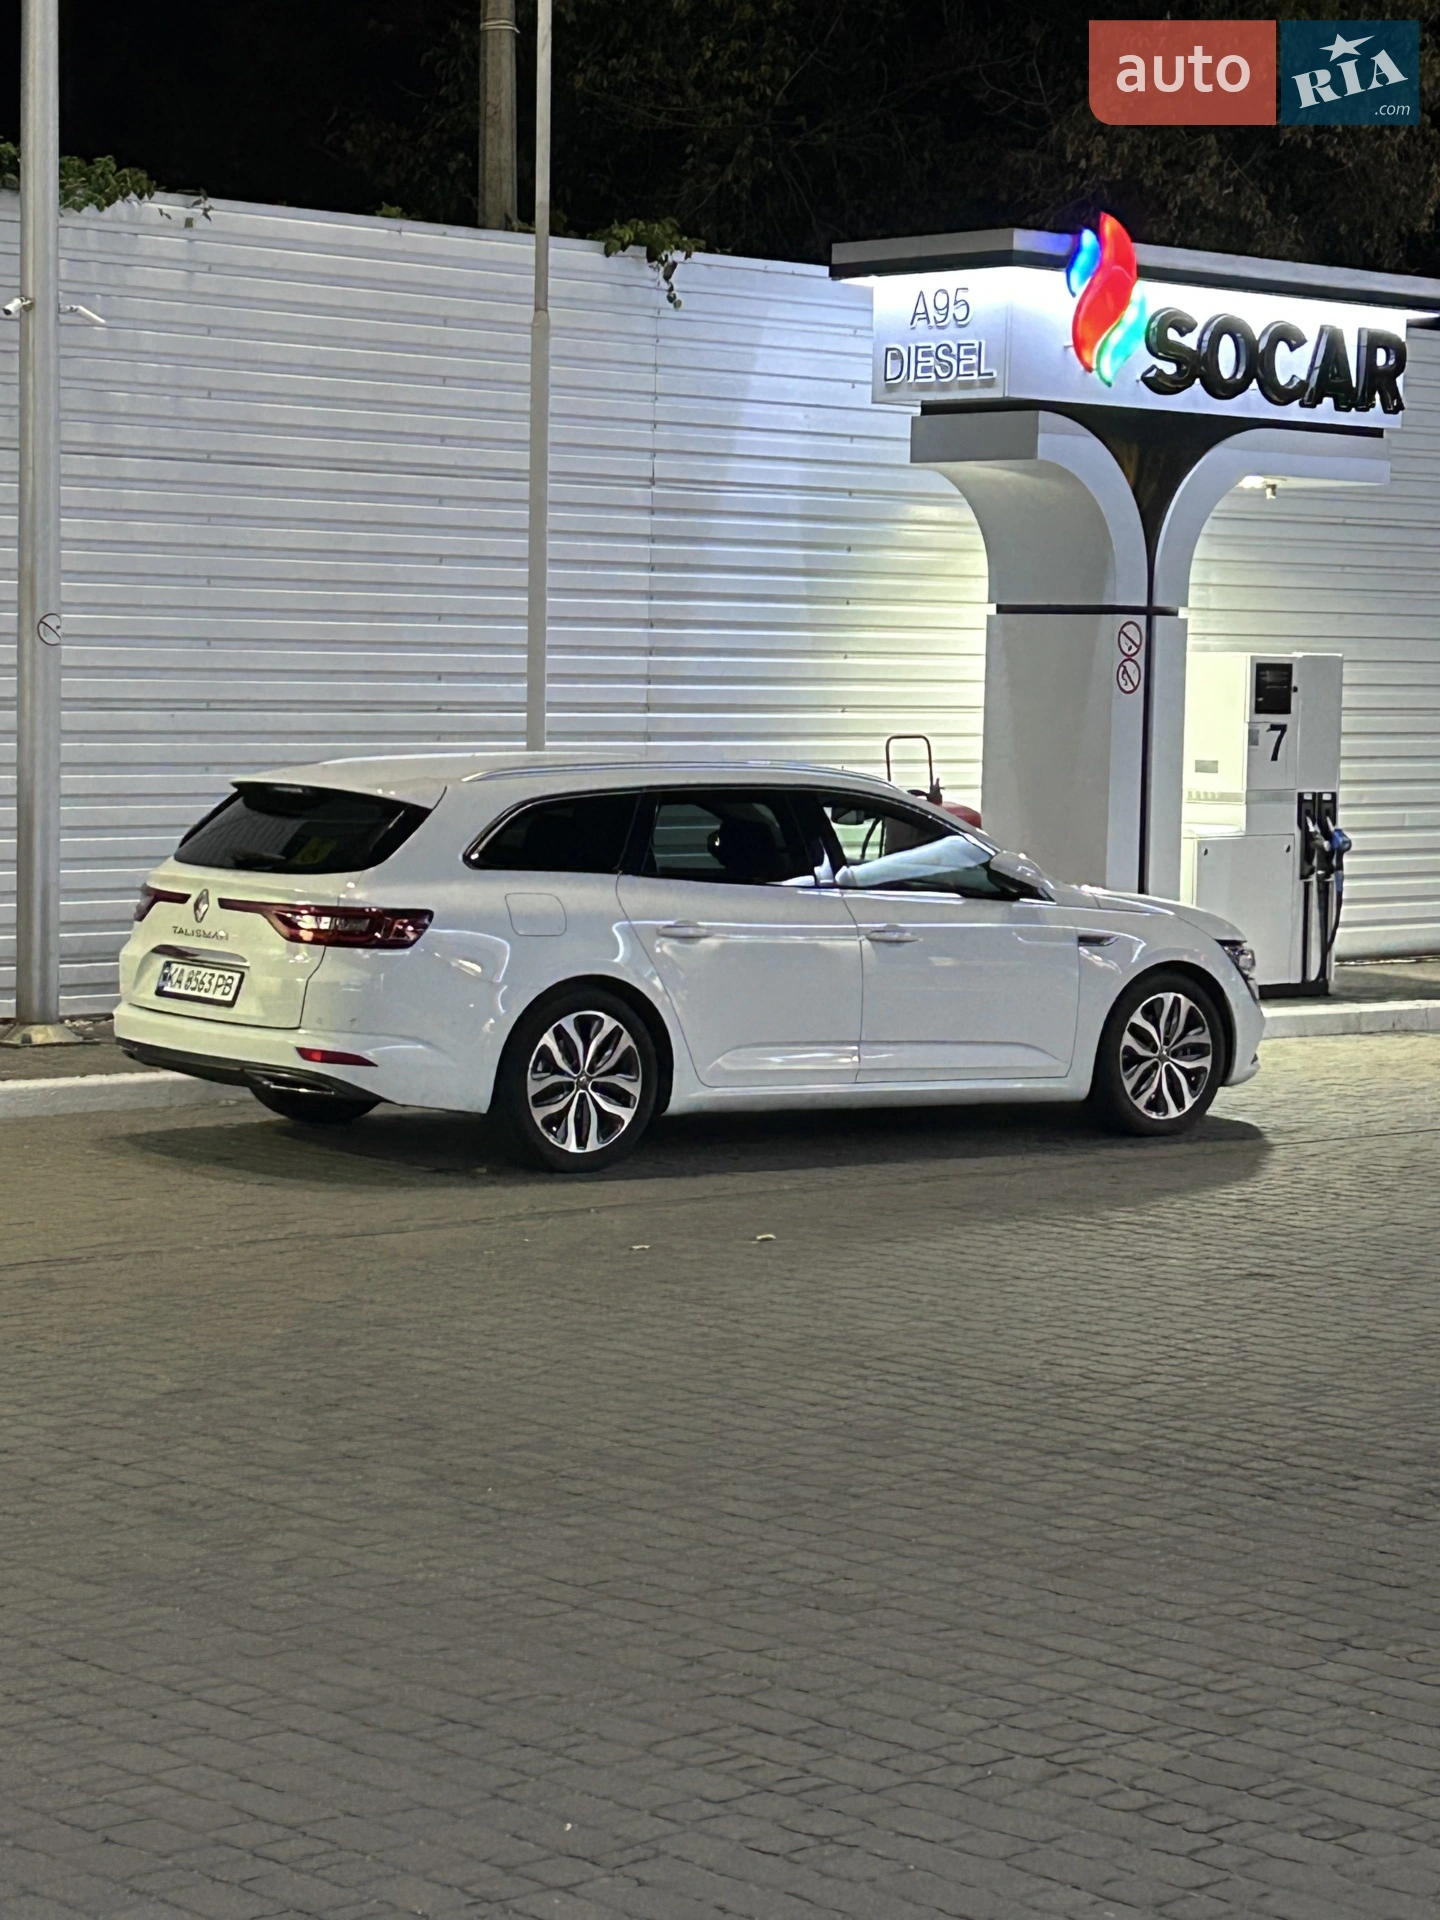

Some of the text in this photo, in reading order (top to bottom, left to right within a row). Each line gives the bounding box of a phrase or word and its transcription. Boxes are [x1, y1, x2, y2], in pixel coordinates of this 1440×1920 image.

[910, 287, 971, 330] A95
[884, 340, 996, 383] DIESEL
[1141, 307, 1407, 414] SOCAR
[1266, 724, 1288, 761] 7
